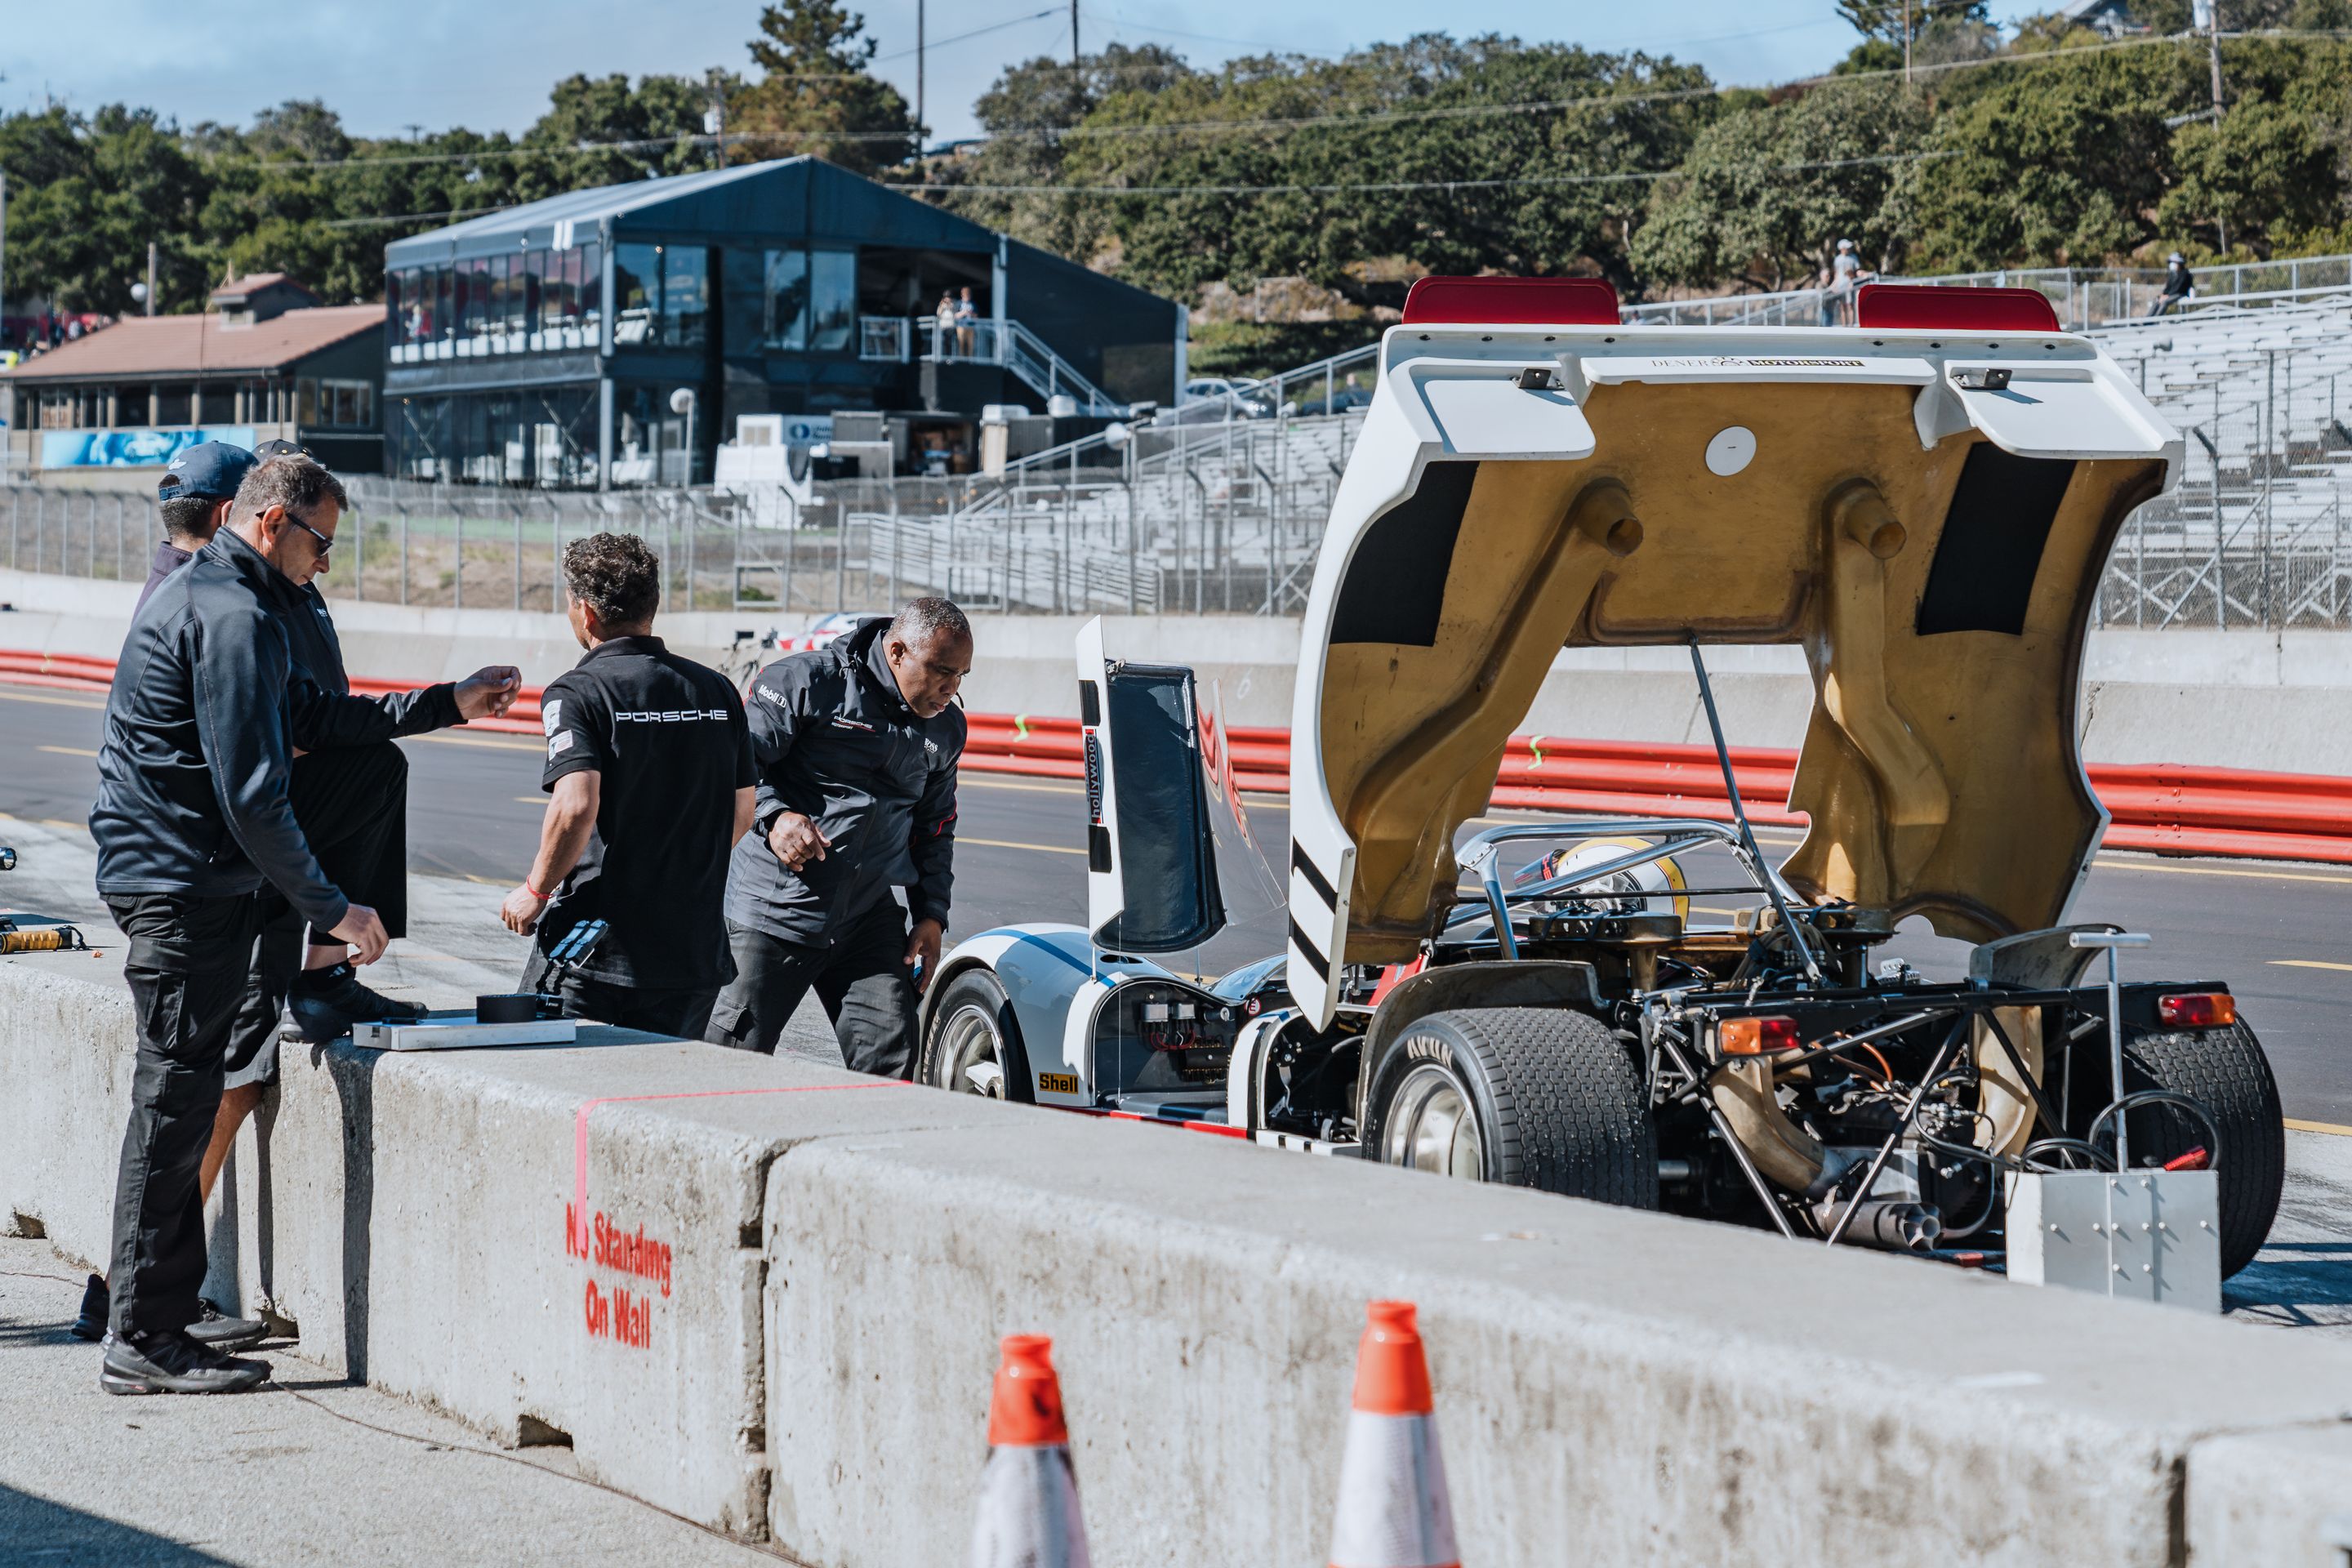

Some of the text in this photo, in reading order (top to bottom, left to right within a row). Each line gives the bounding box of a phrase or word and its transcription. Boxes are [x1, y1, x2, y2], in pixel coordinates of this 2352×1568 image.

[758, 684, 778, 702] Mobil
[615, 710, 728, 723] PORSCHE
[833, 715, 873, 729] PORSCHE
[1087, 733, 1100, 818] hollywood
[1039, 1074, 1078, 1093] Shell
[594, 1210, 672, 1298] Standing
[585, 1279, 650, 1349] On Wall
